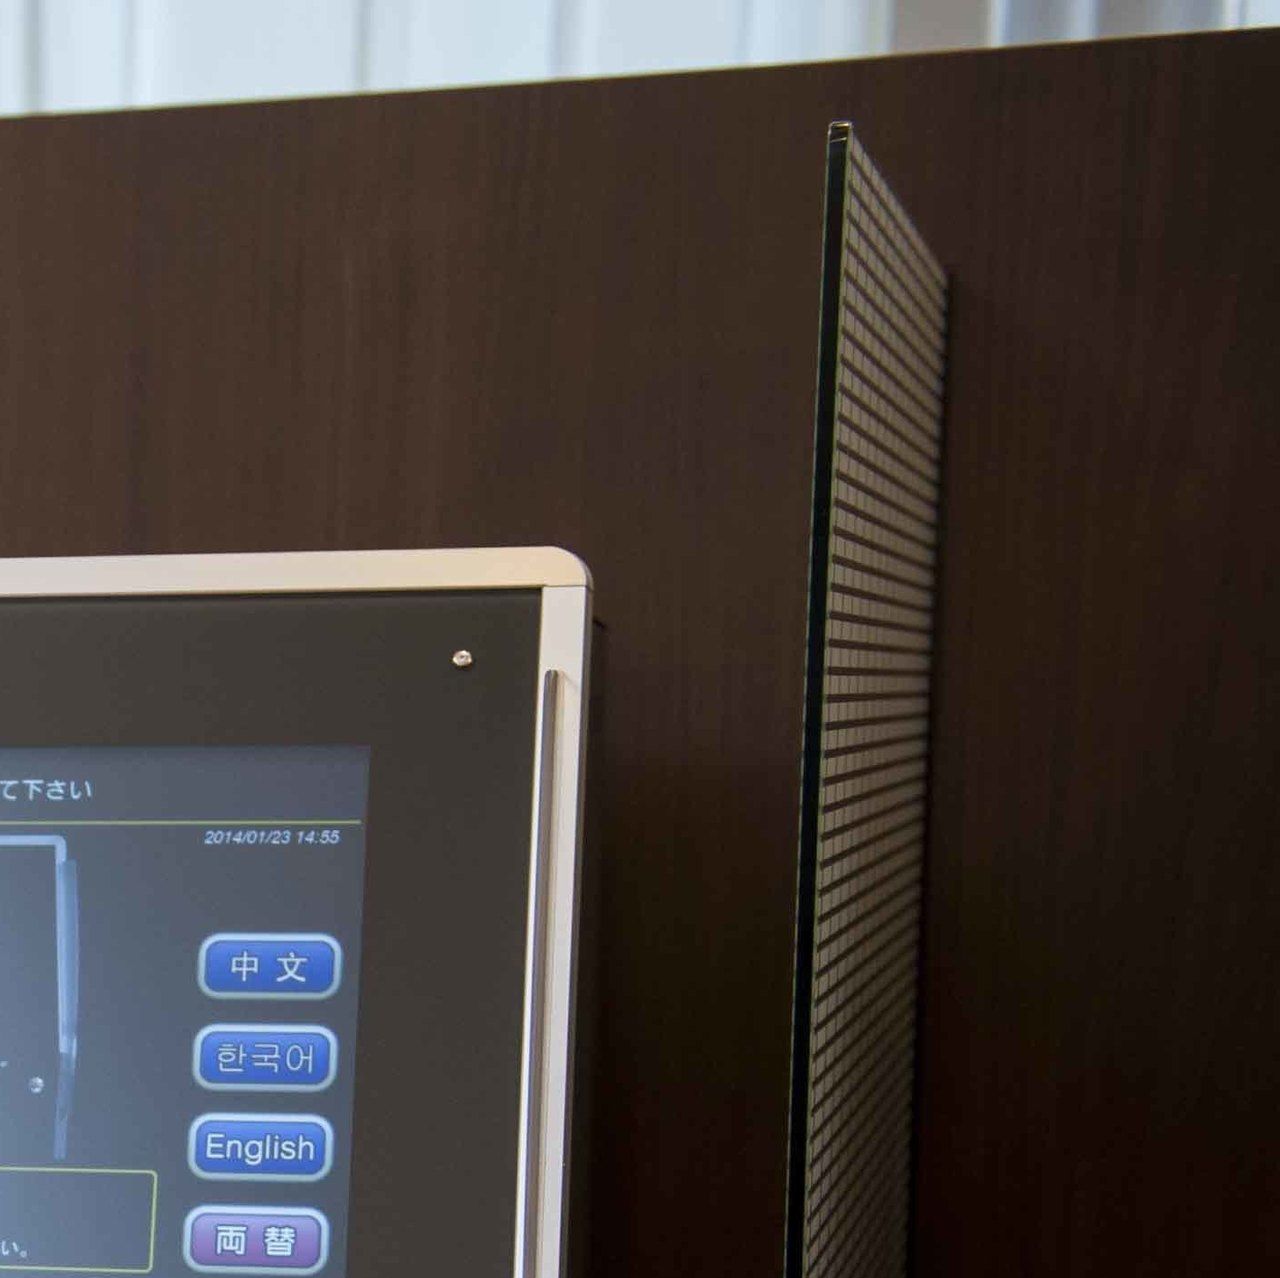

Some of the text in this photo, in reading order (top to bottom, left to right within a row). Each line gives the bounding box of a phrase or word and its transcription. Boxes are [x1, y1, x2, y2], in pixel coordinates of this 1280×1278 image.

[204, 829, 340, 844] 2014/01/23 14:55
[218, 1043, 313, 1073] 한국어
[206, 1133, 315, 1165] English
[216, 1226, 296, 1256] 両替
